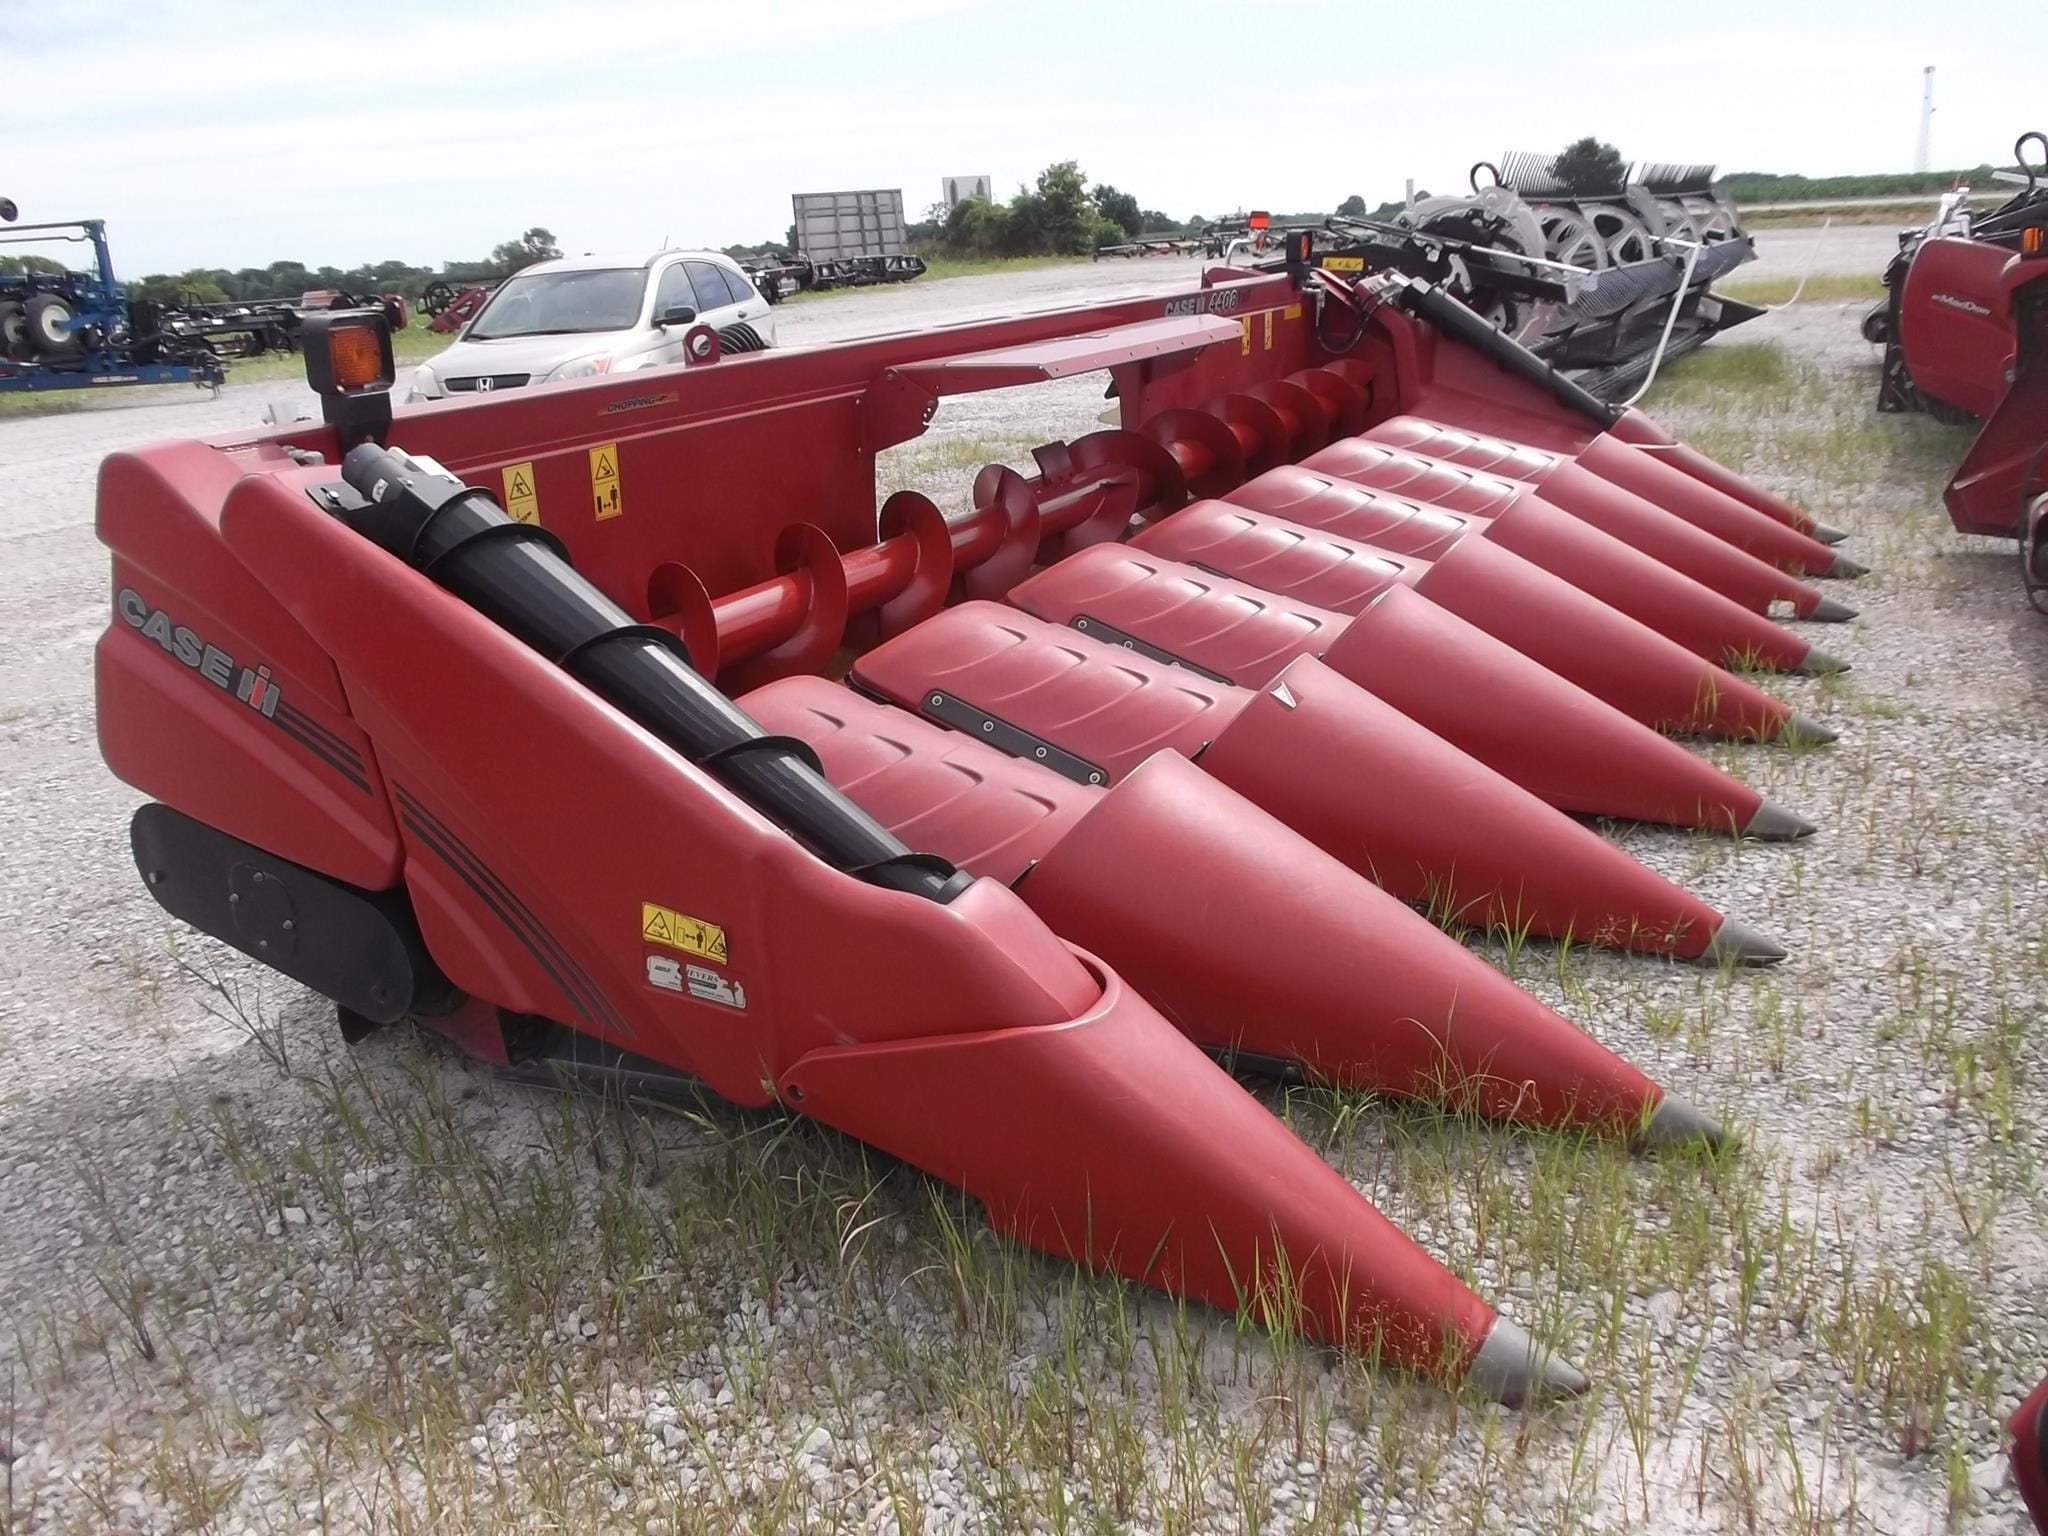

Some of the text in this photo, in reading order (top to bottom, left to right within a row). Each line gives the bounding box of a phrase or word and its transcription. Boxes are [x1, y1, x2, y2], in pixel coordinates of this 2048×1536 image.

[1164, 298, 1195, 317] CASE
[1208, 289, 1238, 313] 4408
[607, 395, 657, 412] CHOPPING
[118, 588, 281, 718] CASE IH
